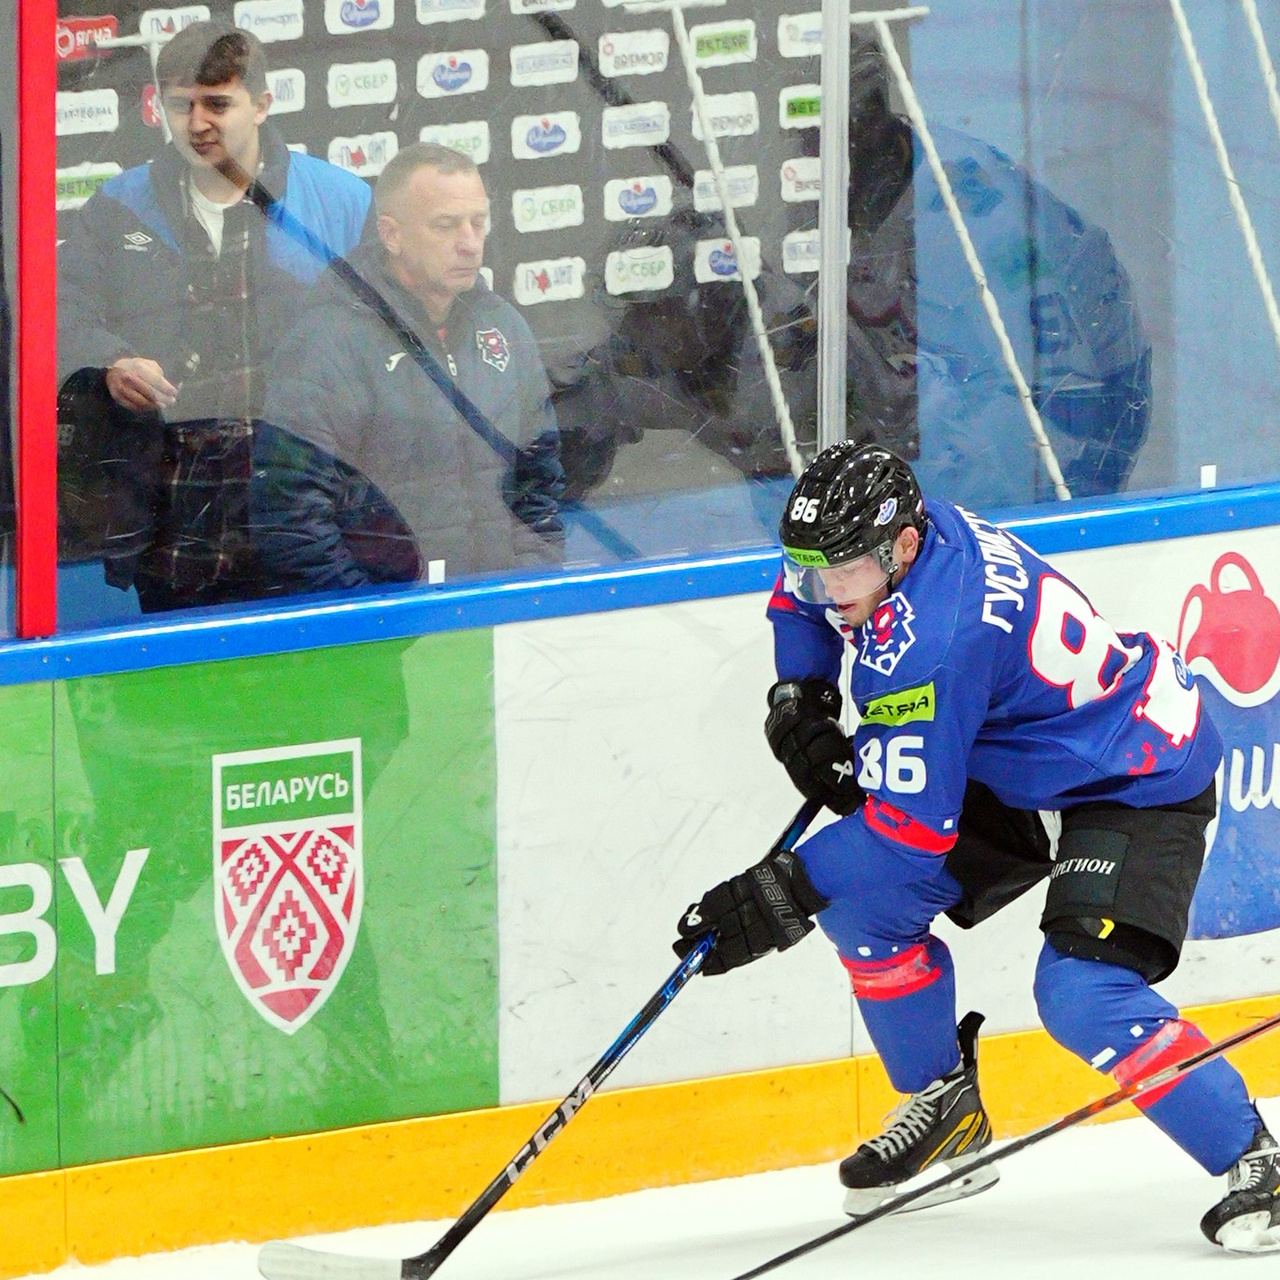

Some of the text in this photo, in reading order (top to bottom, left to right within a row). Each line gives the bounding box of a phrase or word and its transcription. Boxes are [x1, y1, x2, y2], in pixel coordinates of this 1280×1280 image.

[790, 496, 821, 524] 86
[225, 771, 350, 812] БЕЛАРУСЬ
[857, 734, 928, 795] 86
[754, 862, 808, 946] BAUE
[504, 1075, 595, 1185] CCM
